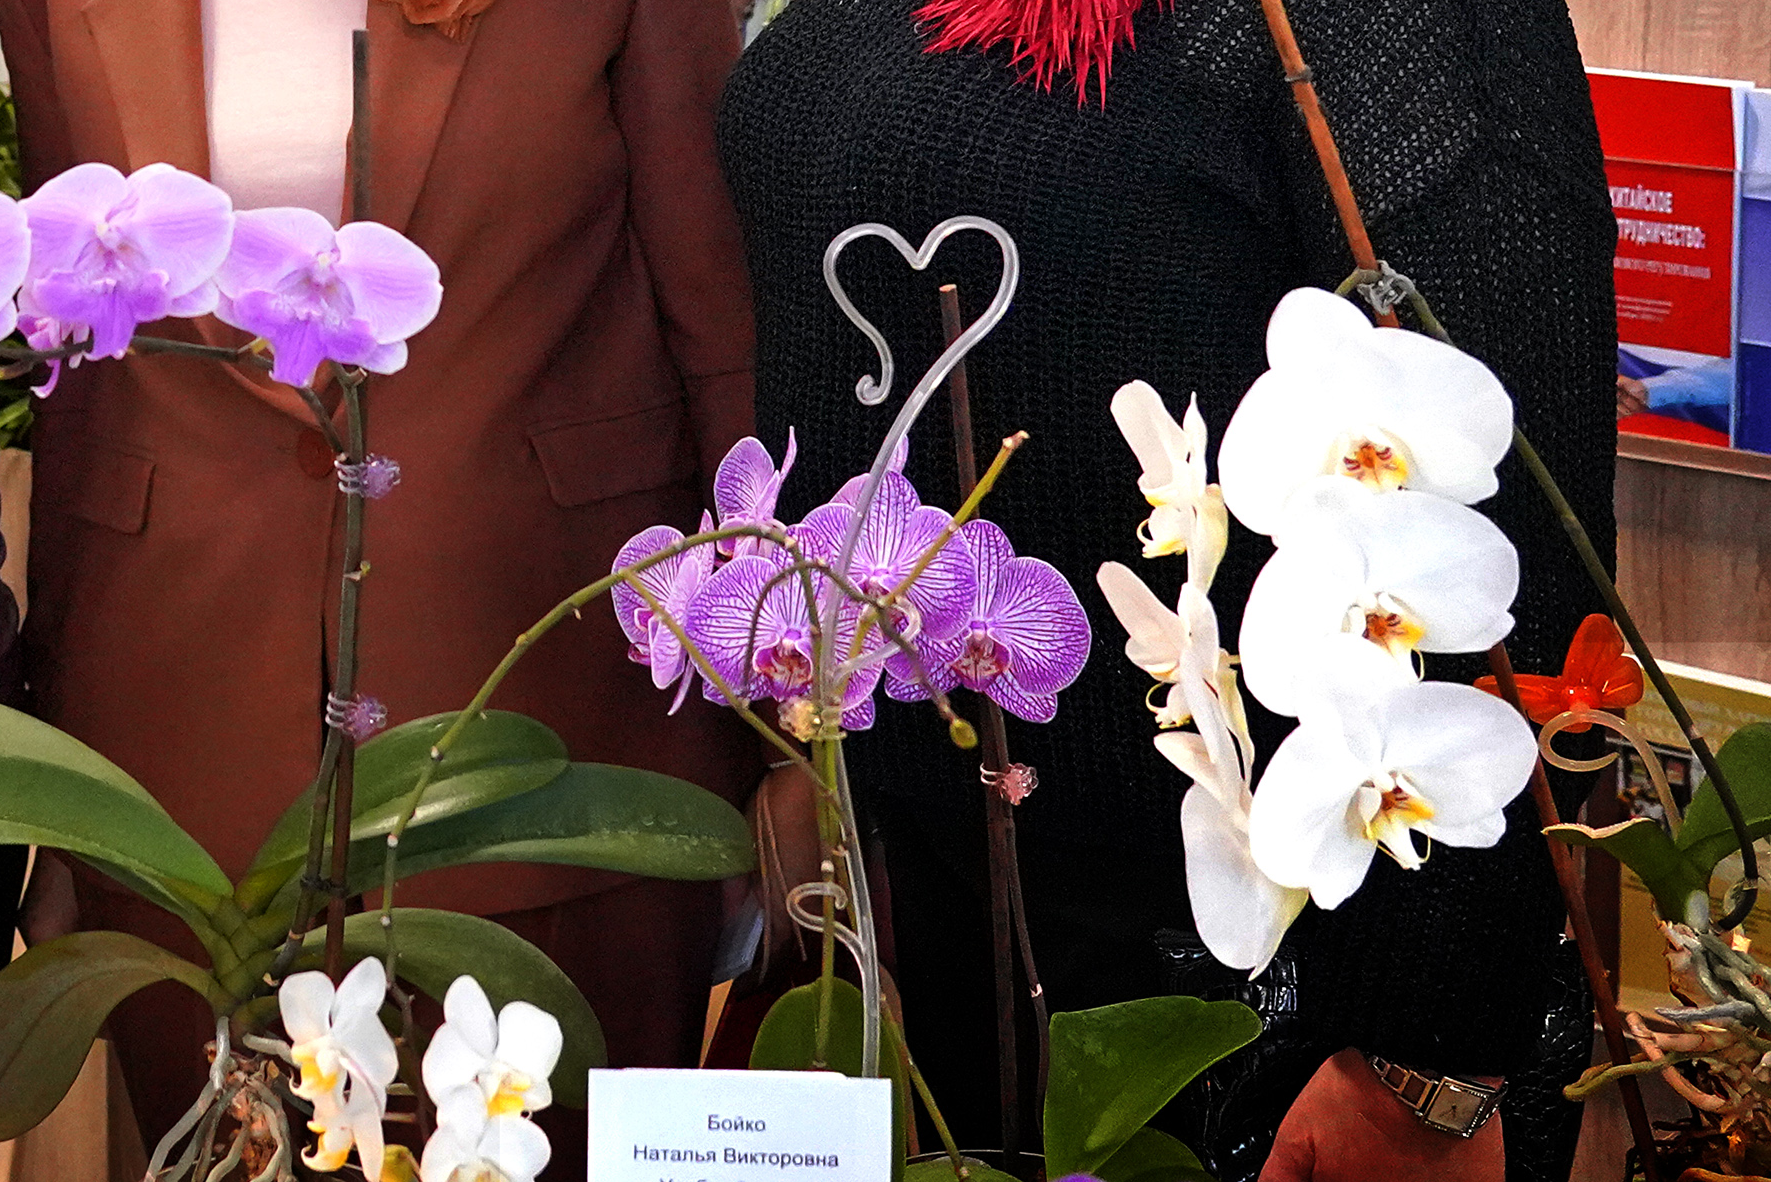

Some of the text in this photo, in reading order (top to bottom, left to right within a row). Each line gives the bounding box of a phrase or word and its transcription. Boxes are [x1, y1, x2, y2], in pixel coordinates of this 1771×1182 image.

[1616, 218, 1706, 249] ТРУДНИЧЕСТВО:
[707, 1114, 766, 1132] Бойко
[633, 1144, 839, 1168] Наталья Викторовна
